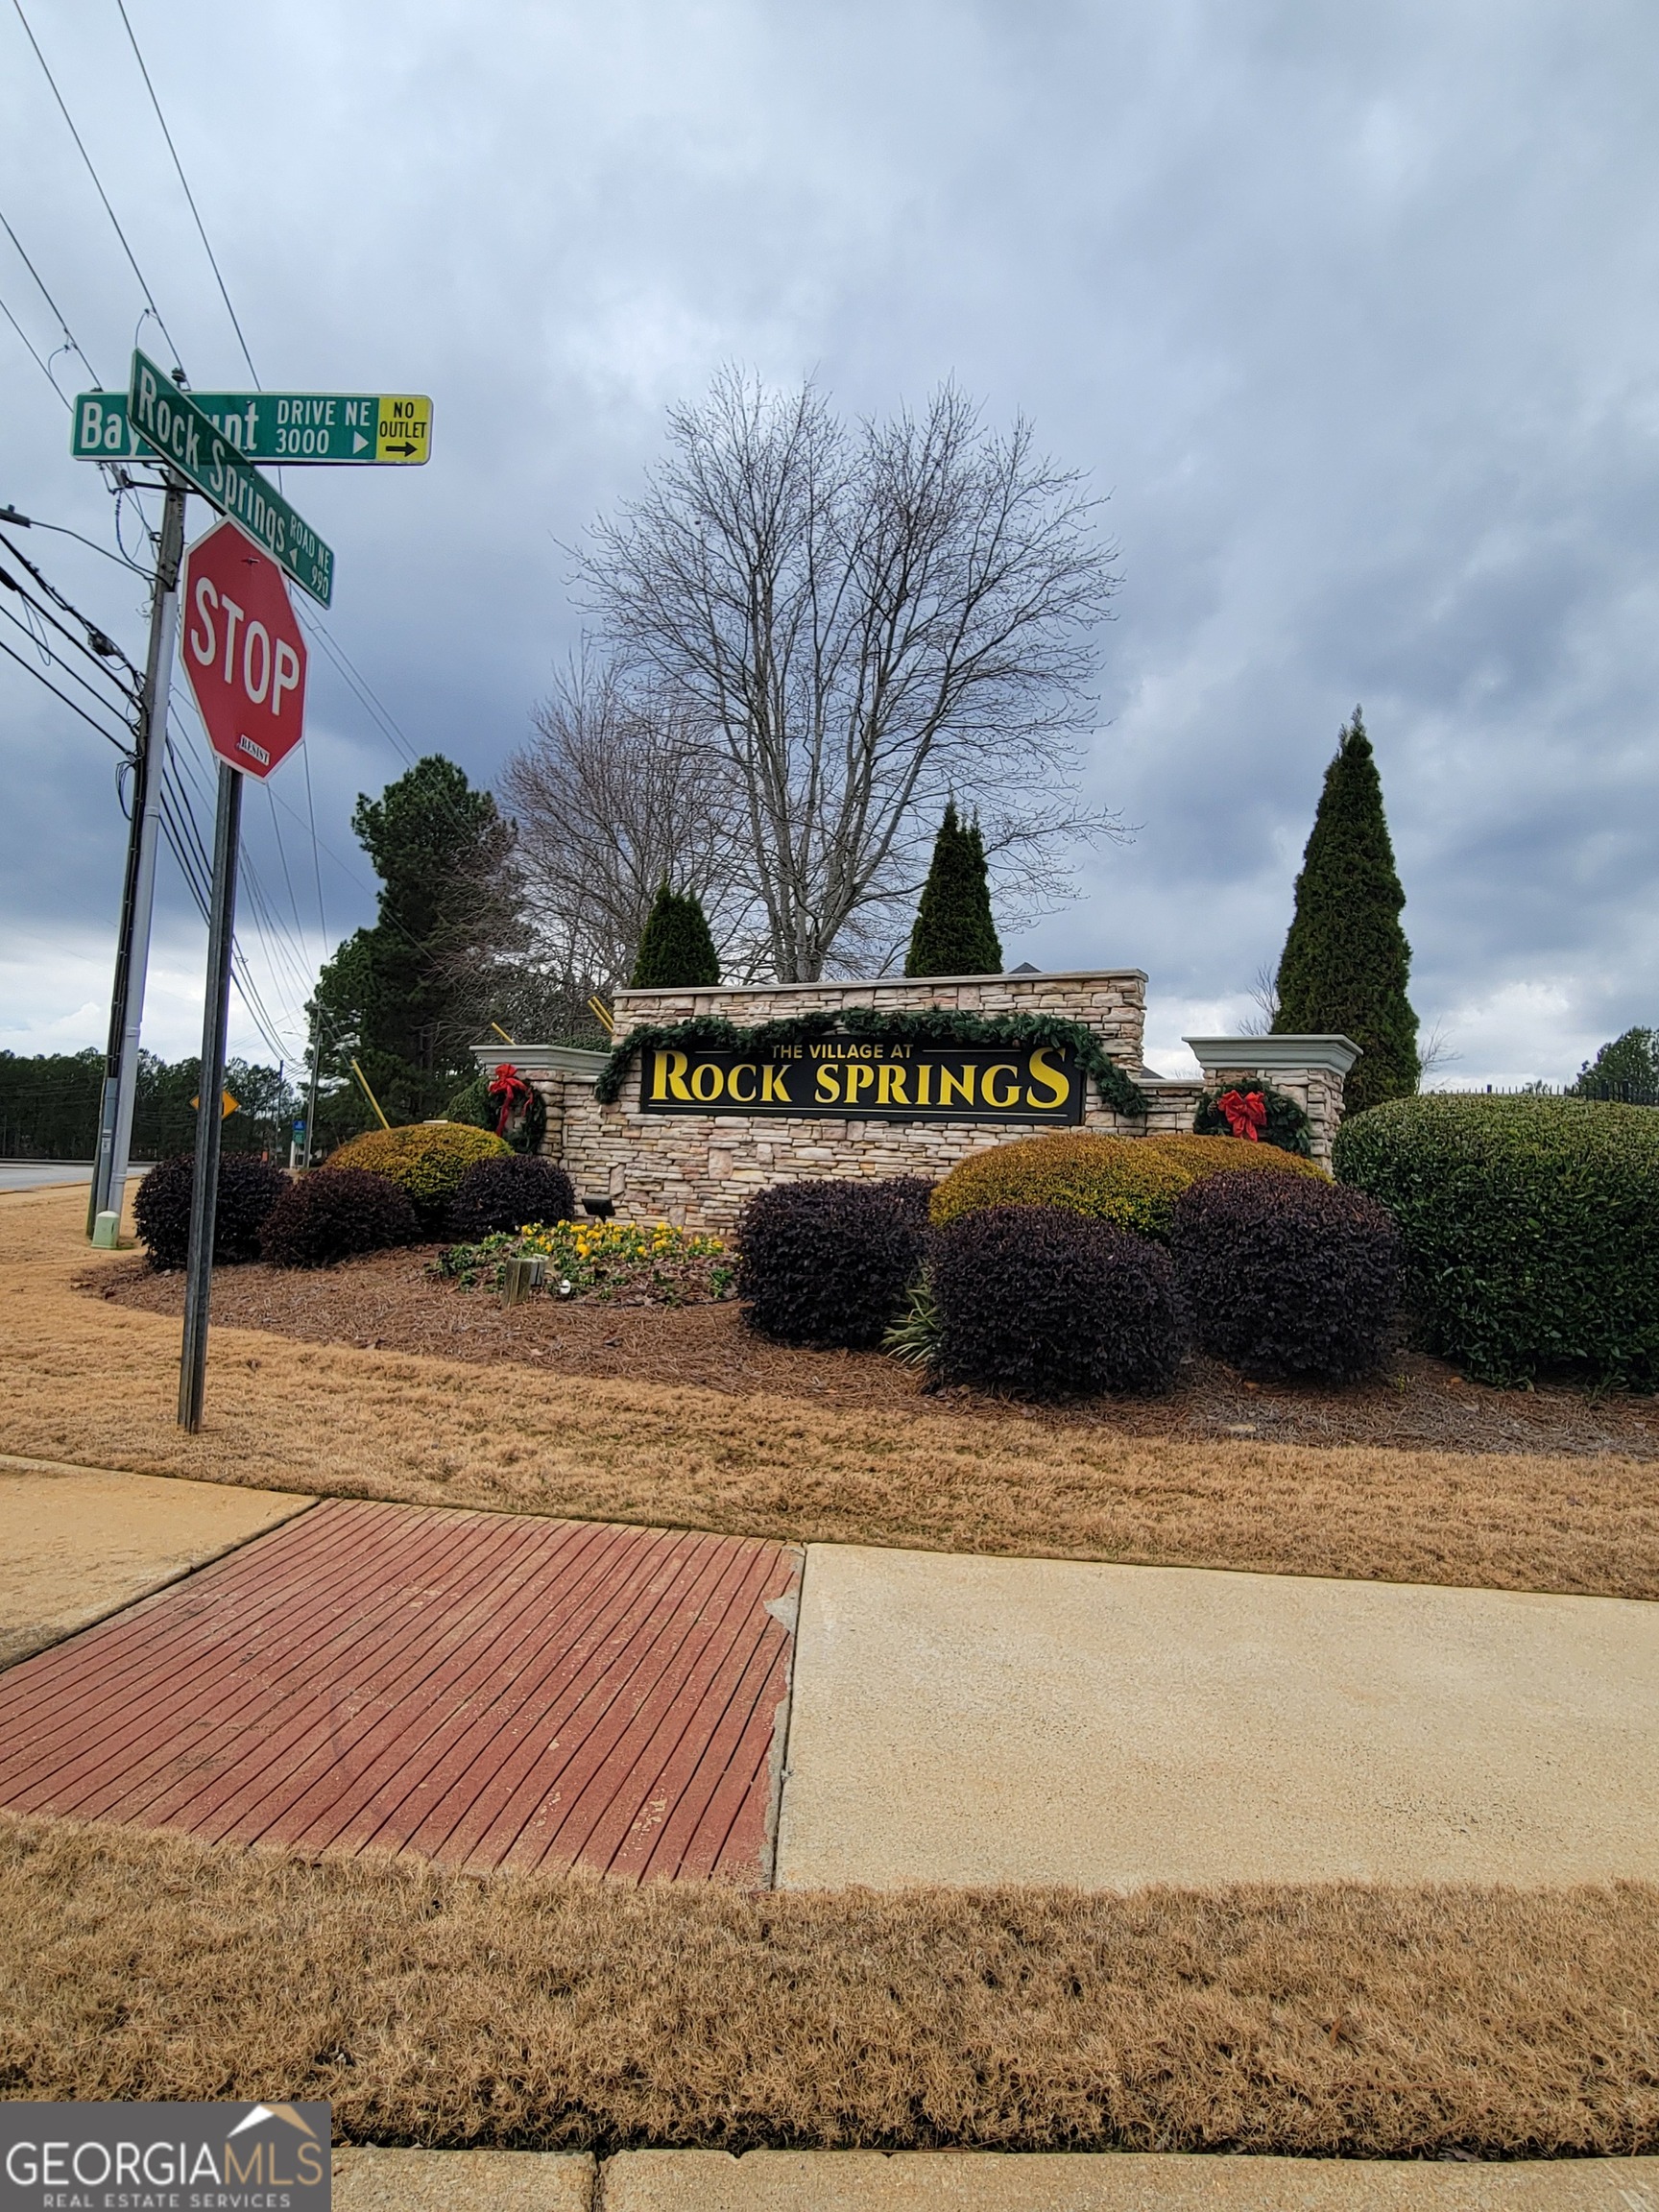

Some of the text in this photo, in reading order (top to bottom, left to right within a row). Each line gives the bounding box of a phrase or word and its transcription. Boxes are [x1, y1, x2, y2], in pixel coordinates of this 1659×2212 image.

[276, 399, 372, 426] DRIVE NE
[394, 401, 414, 419] NO
[81, 401, 259, 458] Baynt
[275, 428, 329, 454] 3000
[379, 421, 427, 439] OUTLET
[138, 366, 285, 554] Rock Springs
[290, 514, 330, 574] ROAD NE
[311, 565, 329, 599] 990
[191, 576, 301, 716] STOP
[241, 736, 269, 764] RESIST
[771, 1044, 914, 1059] THE VILLAGE AT
[648, 1046, 1070, 1109] ROCK SPRINGS
